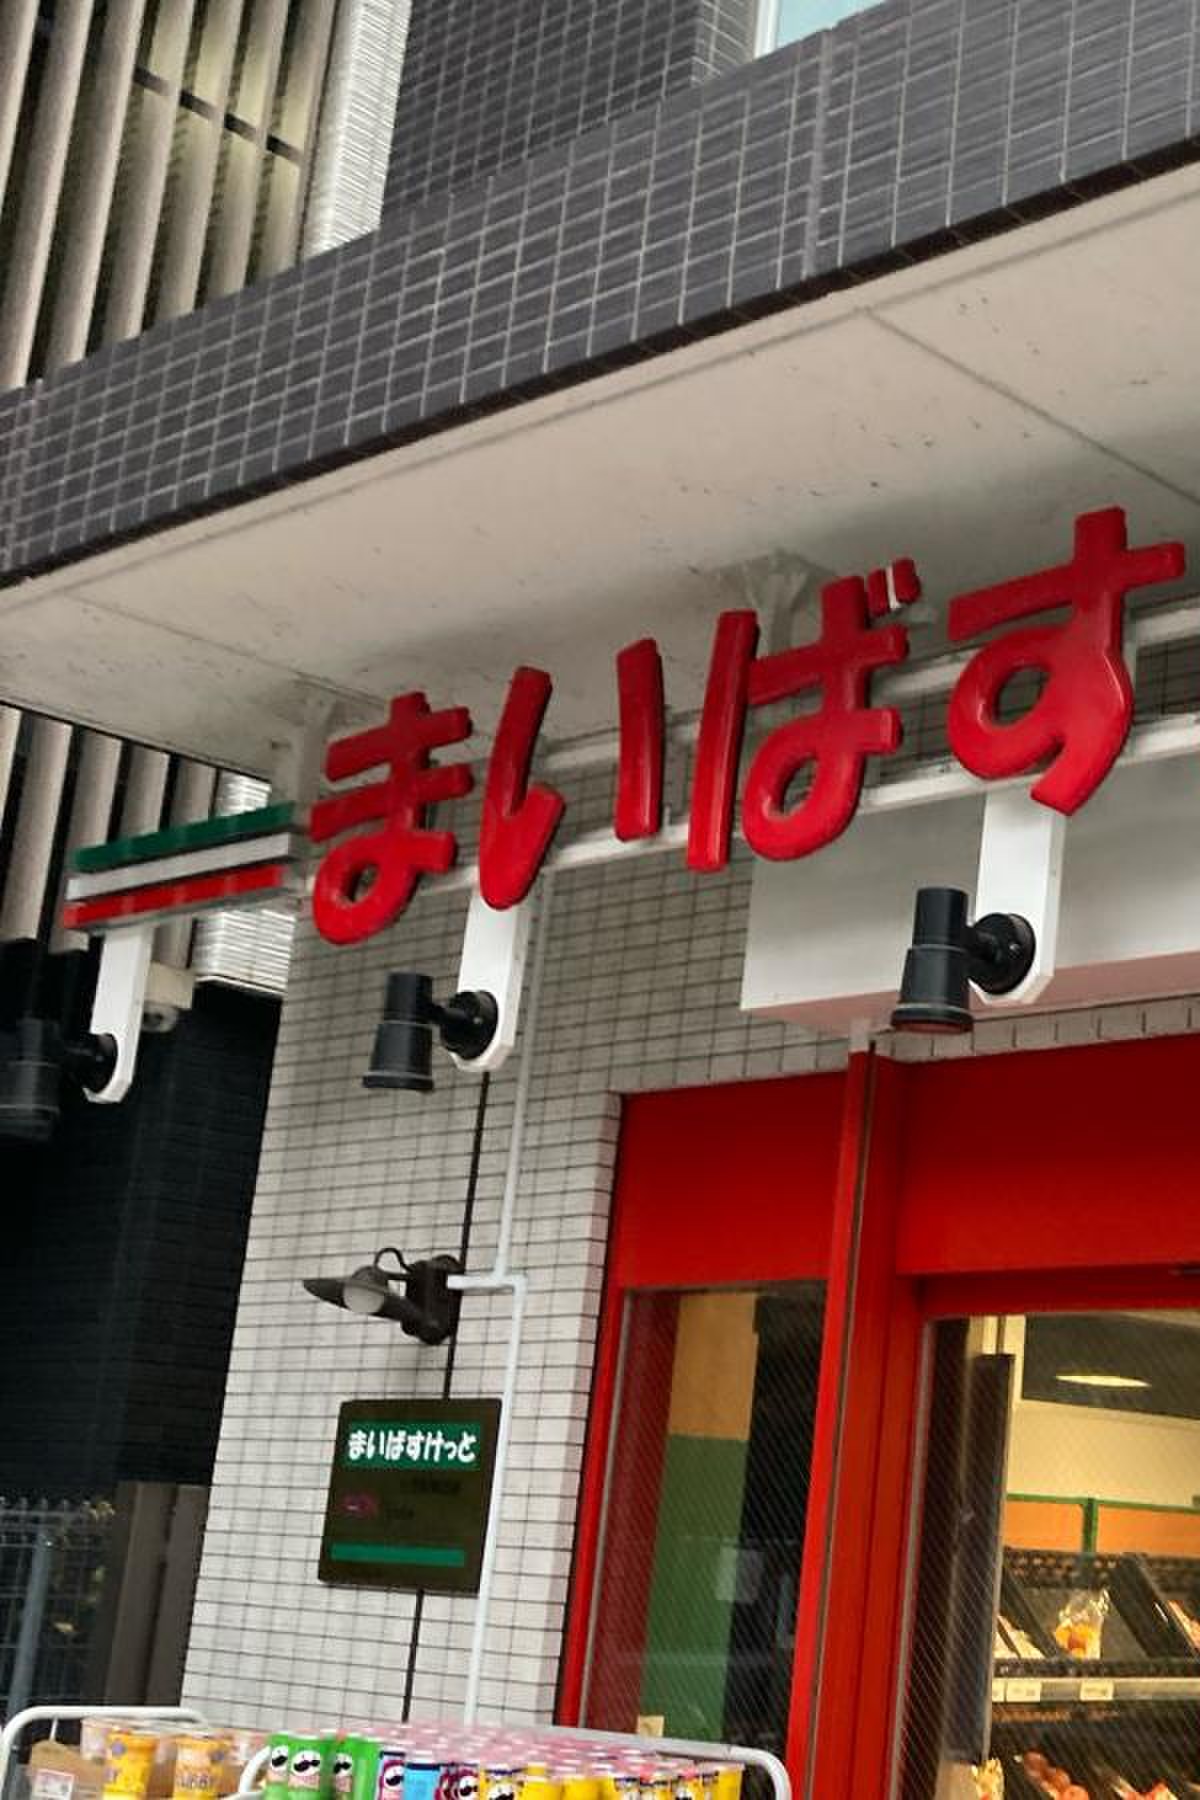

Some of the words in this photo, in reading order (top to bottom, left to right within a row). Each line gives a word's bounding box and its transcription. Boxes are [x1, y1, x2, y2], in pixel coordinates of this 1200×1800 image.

[348, 1429, 477, 1462] まいばすけっと
